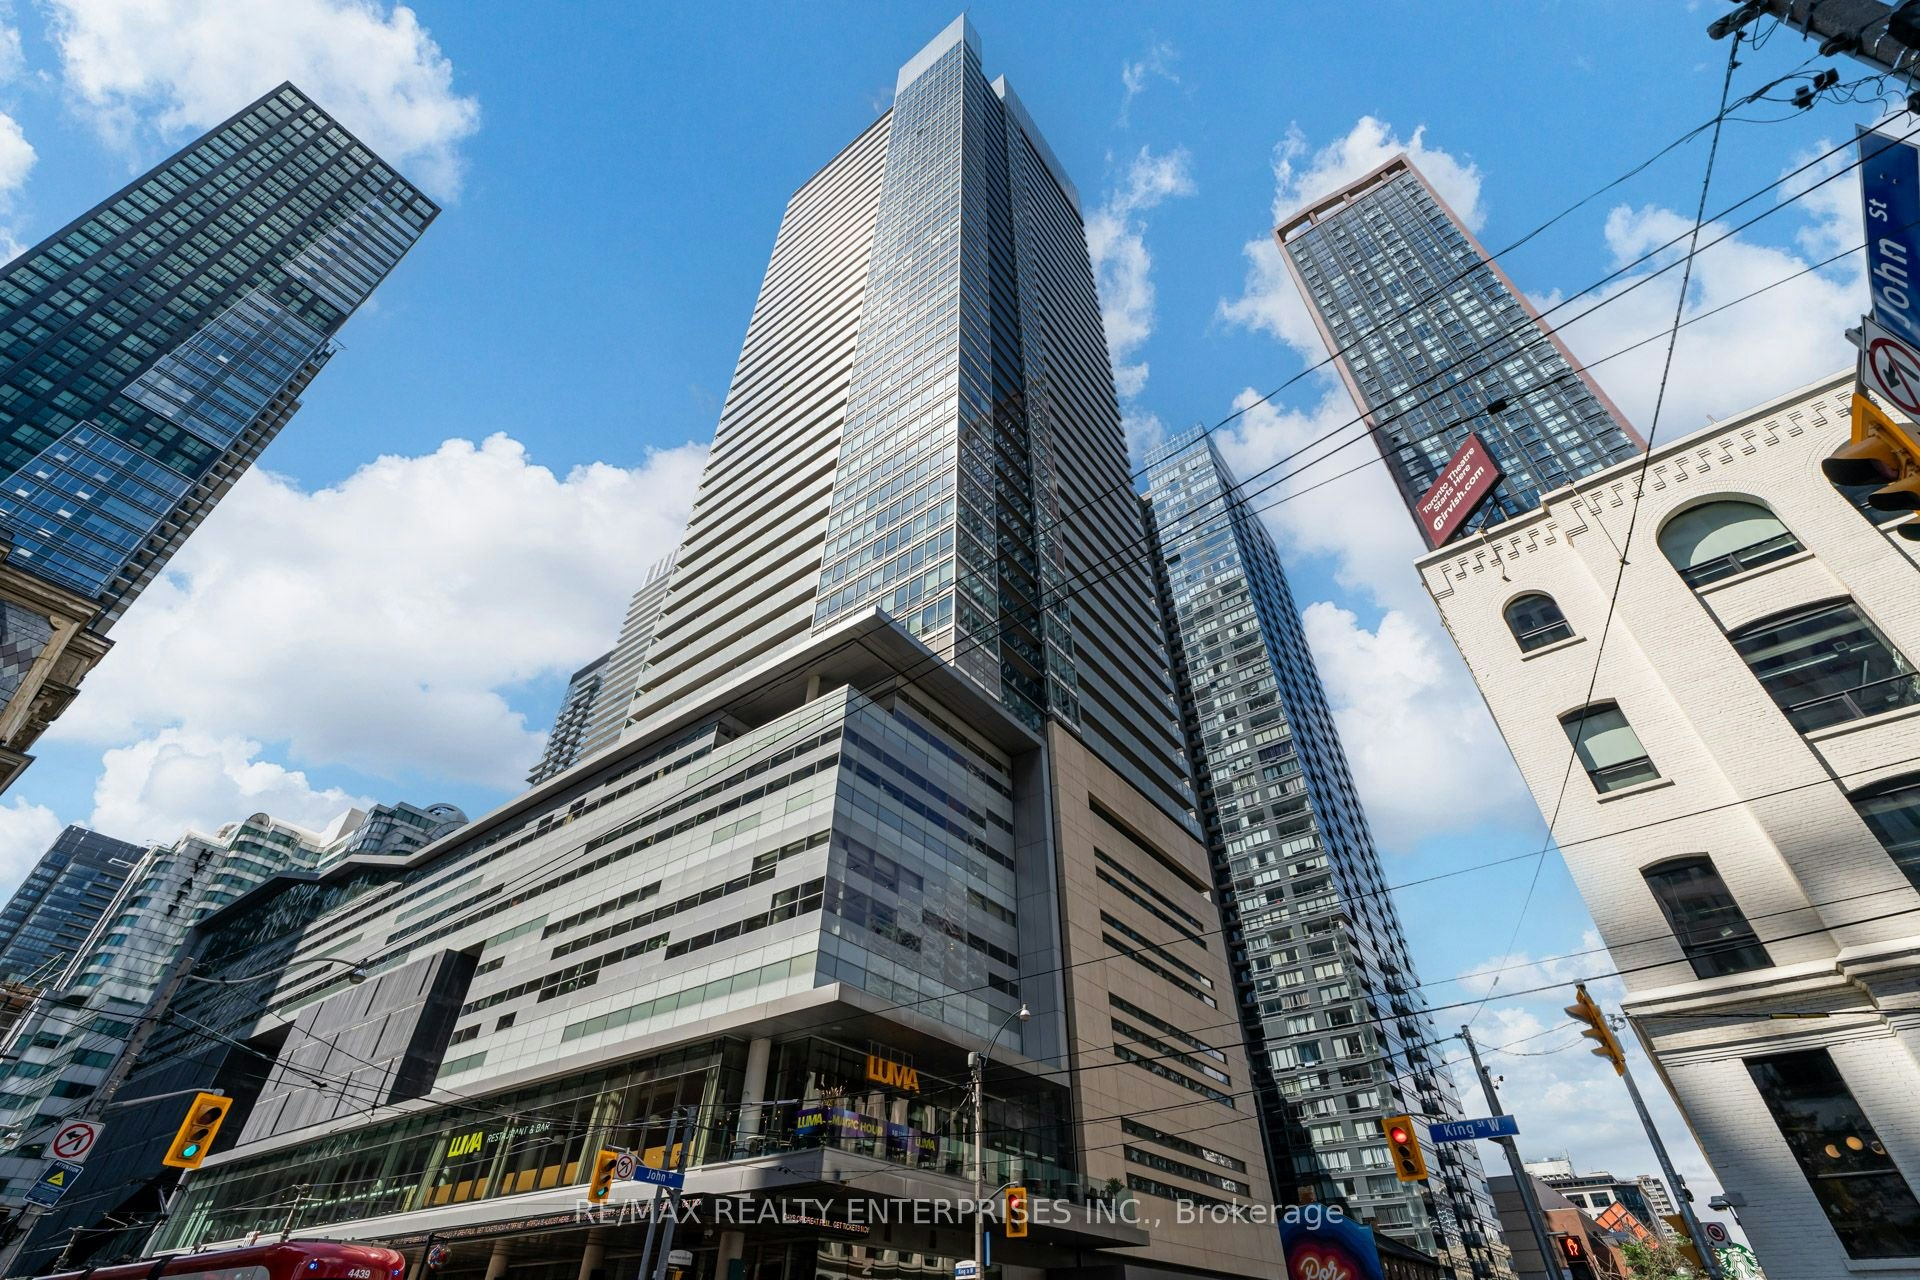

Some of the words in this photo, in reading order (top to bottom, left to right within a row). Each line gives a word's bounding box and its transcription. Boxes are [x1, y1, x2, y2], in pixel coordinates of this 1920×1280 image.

[1873, 238, 1911, 330] John
[1422, 482, 1449, 514] Toronto
[1447, 447, 1475, 481] Theatre
[1433, 486, 1454, 512] Starts
[1452, 464, 1471, 487] Here
[167, 848, 214, 917] HYATT
[867, 1055, 920, 1094] LUMA
[797, 1113, 823, 1129] LUMA
[860, 1121, 883, 1136] HOUR
[1443, 1123, 1475, 1138] King
[1487, 1118, 1500, 1131] W
[447, 1131, 483, 1158] LUMA
[529, 1125, 535, 1135] &
[535, 1121, 551, 1133] BAR
[915, 1136, 936, 1152] LUMA
[646, 1169, 666, 1182] John
[348, 1268, 371, 1279] 4439
